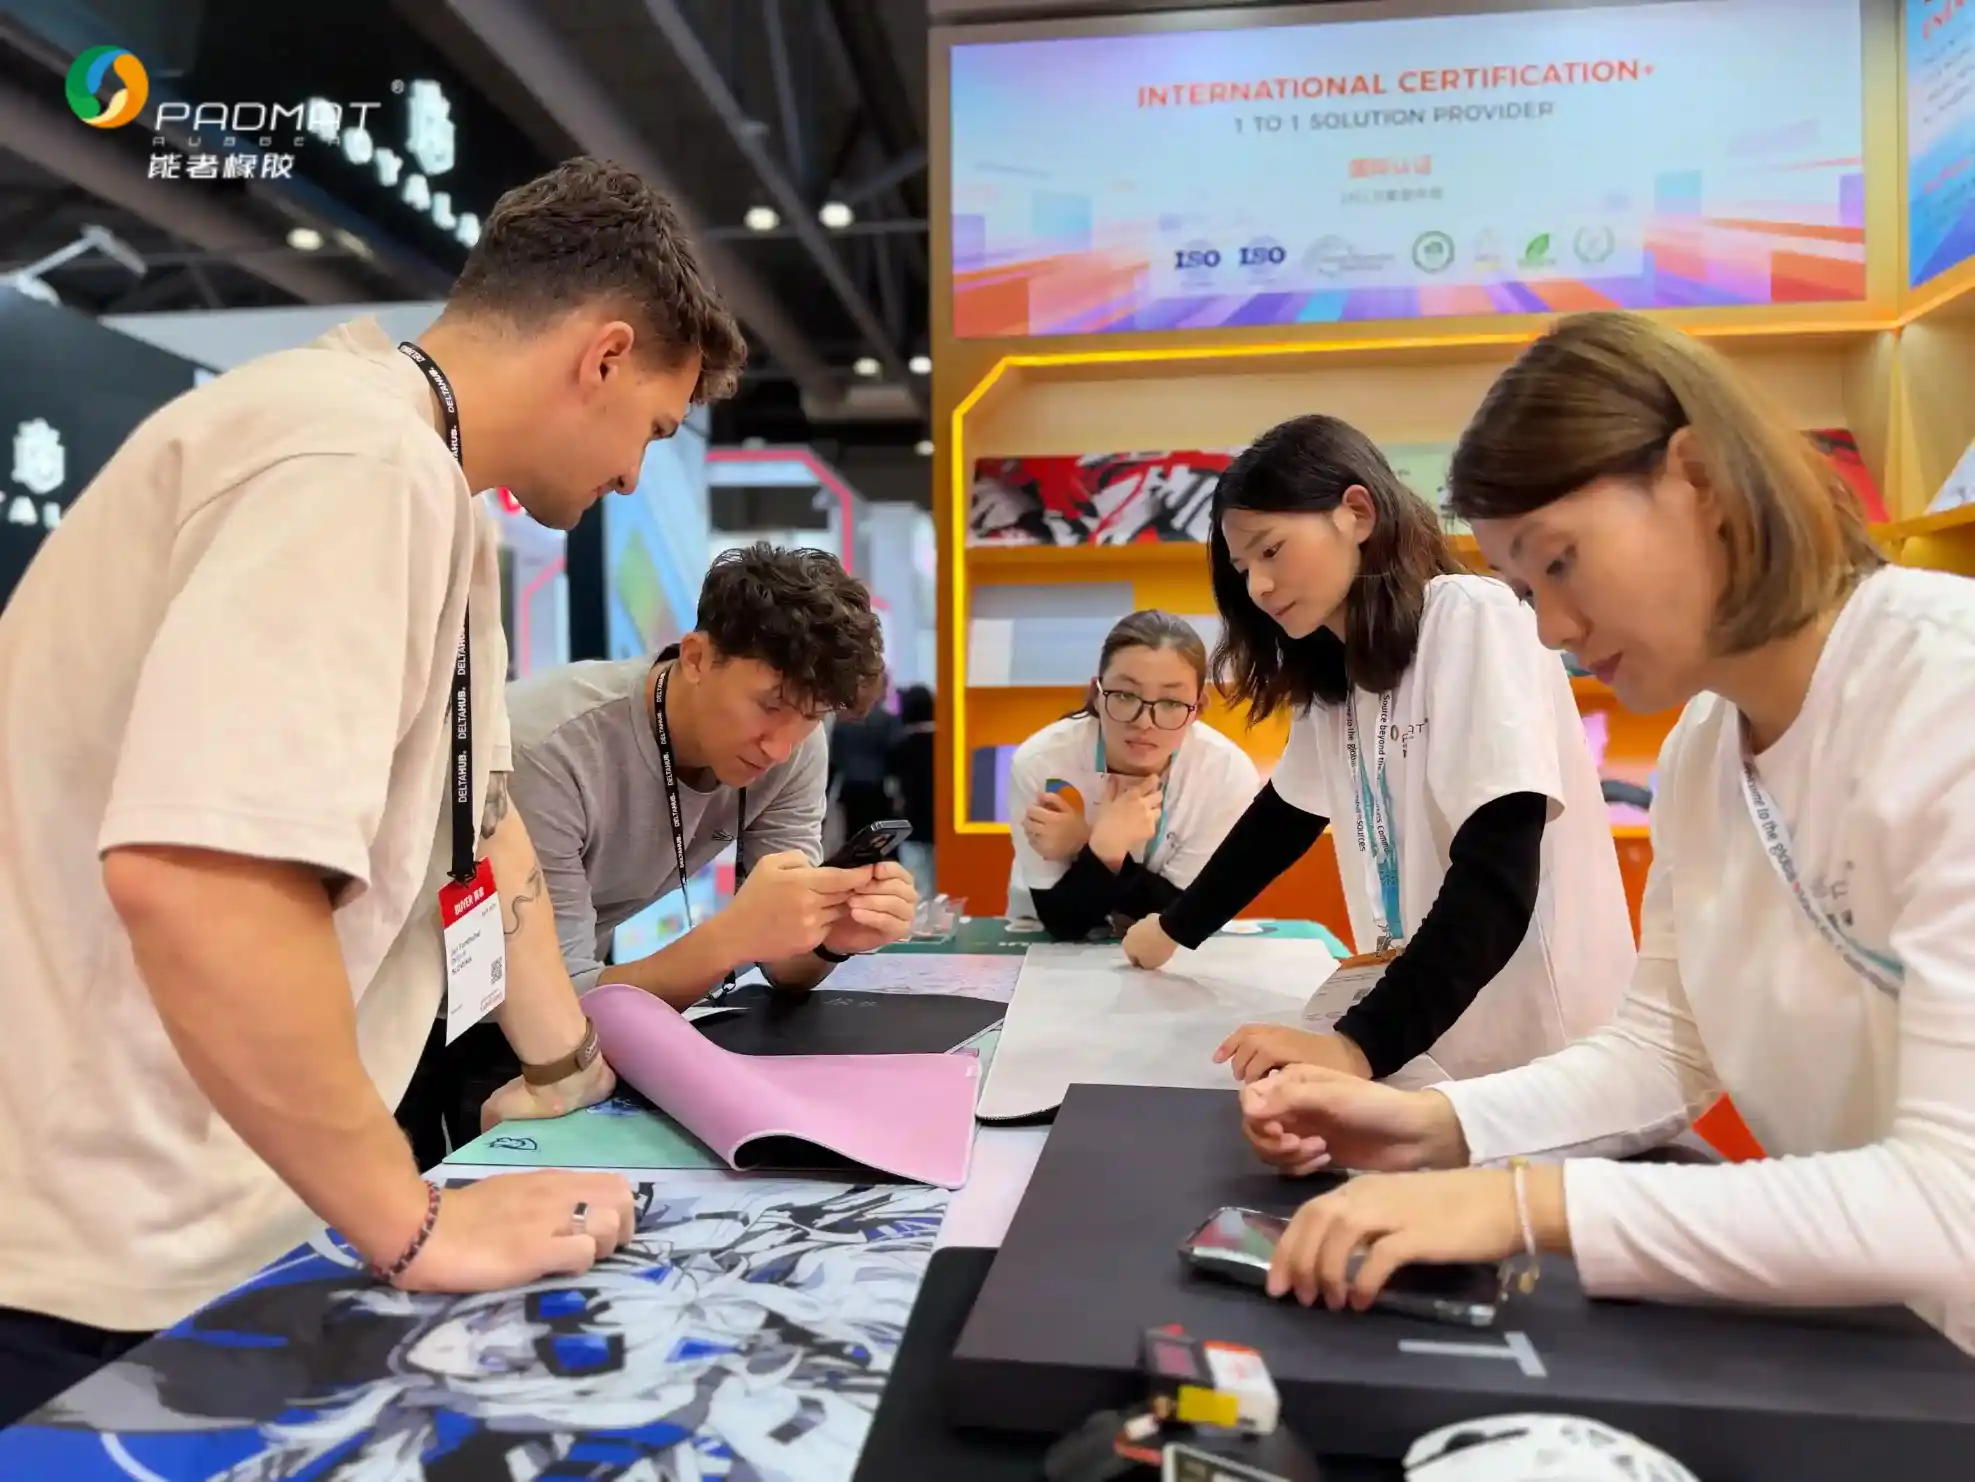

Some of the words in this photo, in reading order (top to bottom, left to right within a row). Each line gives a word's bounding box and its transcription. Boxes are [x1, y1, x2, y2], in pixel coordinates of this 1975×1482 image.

[1138, 74, 1387, 108] INTERNATIONAL
[1235, 117, 1243, 134] 1
[1253, 115, 1282, 132] TO
[1291, 115, 1299, 132] 1
[1310, 108, 1425, 131] SOLUTION
[1433, 101, 1554, 123] PROVIDER
[1175, 251, 1221, 269] ISO
[1239, 247, 1286, 265] ISO
[457, 686, 467, 740] DELTAHUB.
[1381, 694, 1390, 723] Source
[1377, 725, 1388, 755] beyond
[457, 750, 468, 804] DELTAHUB.
